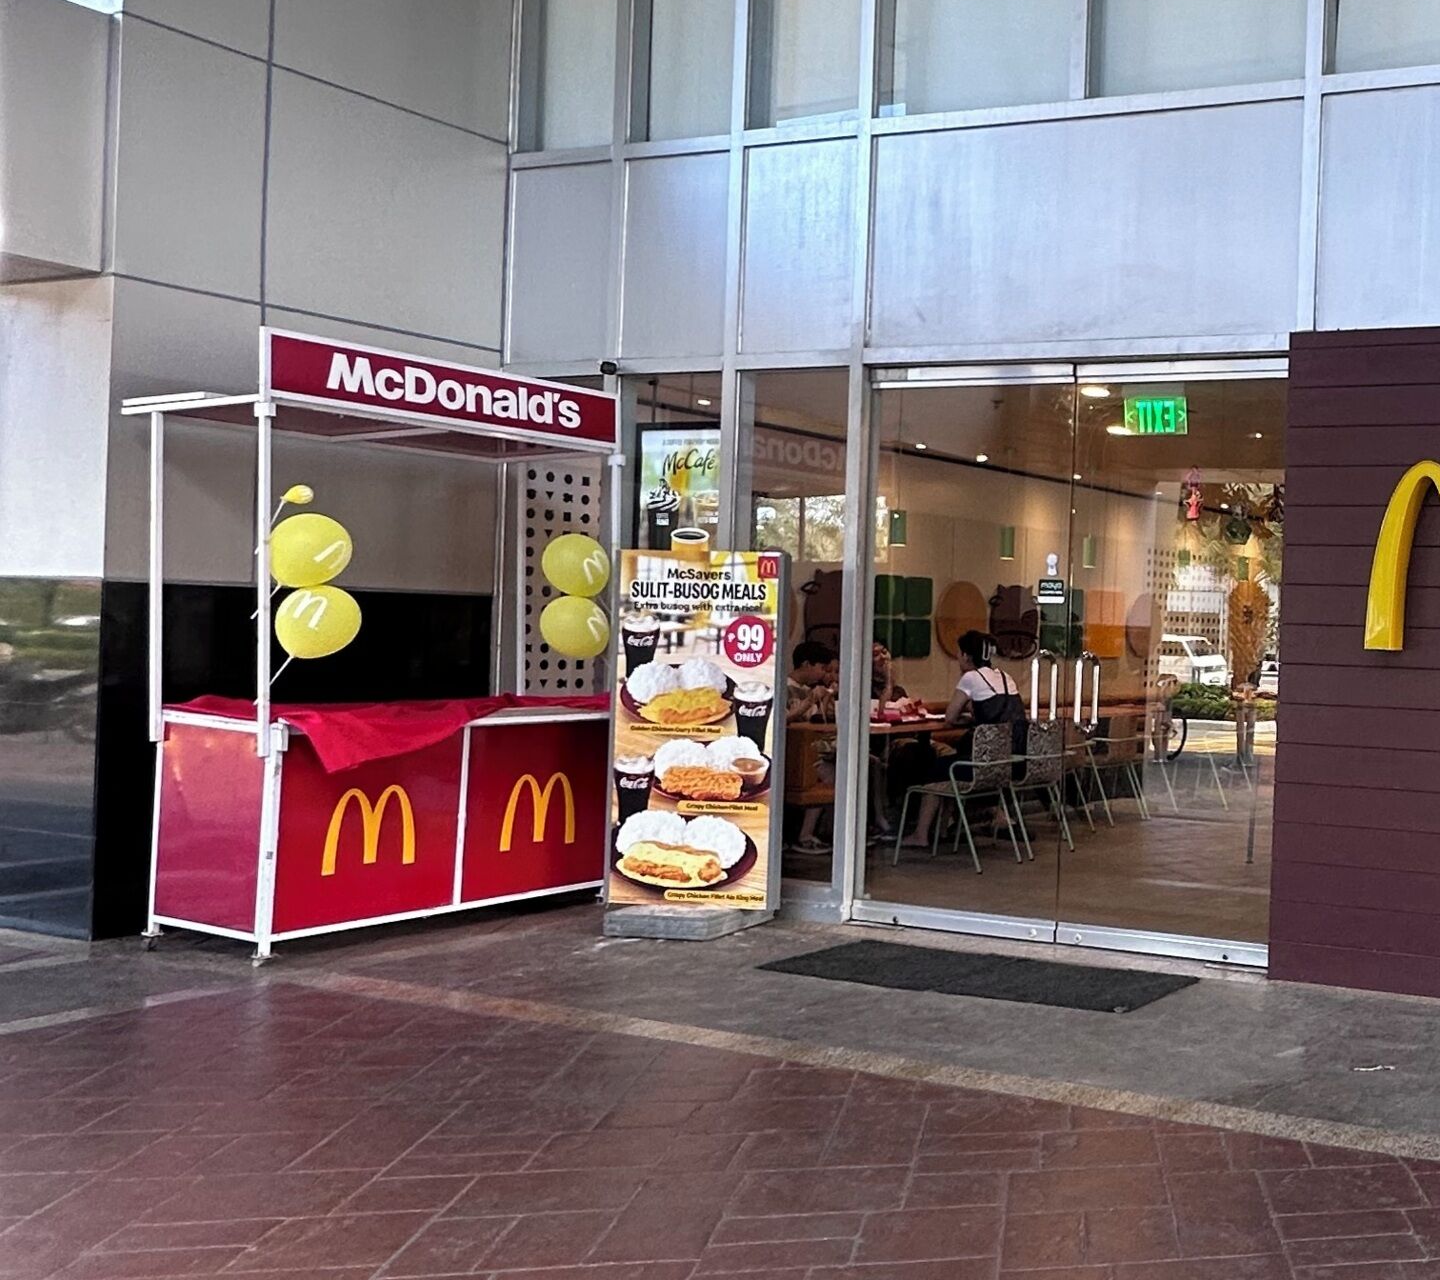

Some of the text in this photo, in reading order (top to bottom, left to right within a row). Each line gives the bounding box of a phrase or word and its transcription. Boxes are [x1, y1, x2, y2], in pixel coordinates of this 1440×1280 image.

[326, 352, 581, 428] McDonald's
[667, 568, 732, 580] McSavers
[631, 581, 767, 601] SULIT-BUSOG MEALS
[634, 601, 659, 610] Extra
[692, 602, 713, 611] with
[733, 652, 763, 662] ONLY
